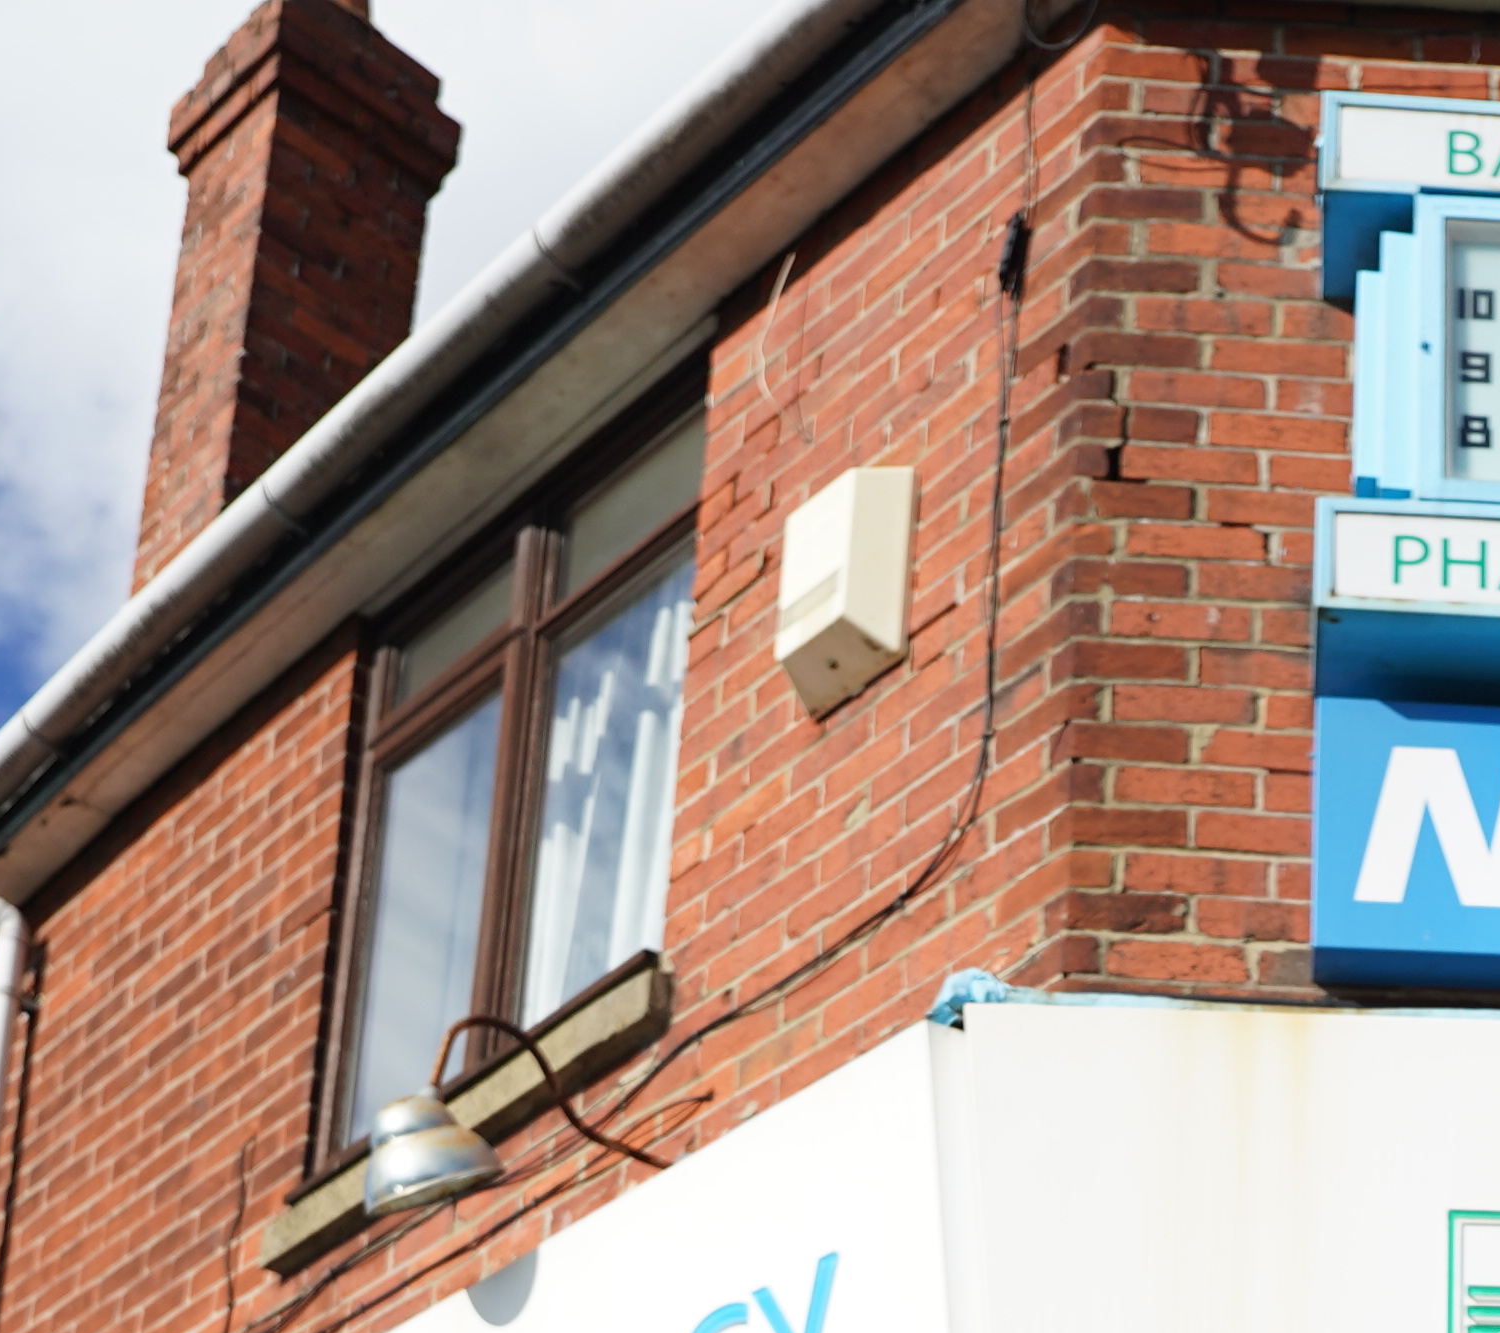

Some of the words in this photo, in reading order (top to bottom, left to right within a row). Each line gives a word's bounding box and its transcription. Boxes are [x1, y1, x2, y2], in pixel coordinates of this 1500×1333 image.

[1459, 288, 1494, 320] 10
[1461, 352, 1490, 382] 9
[1460, 415, 1490, 448] 8
